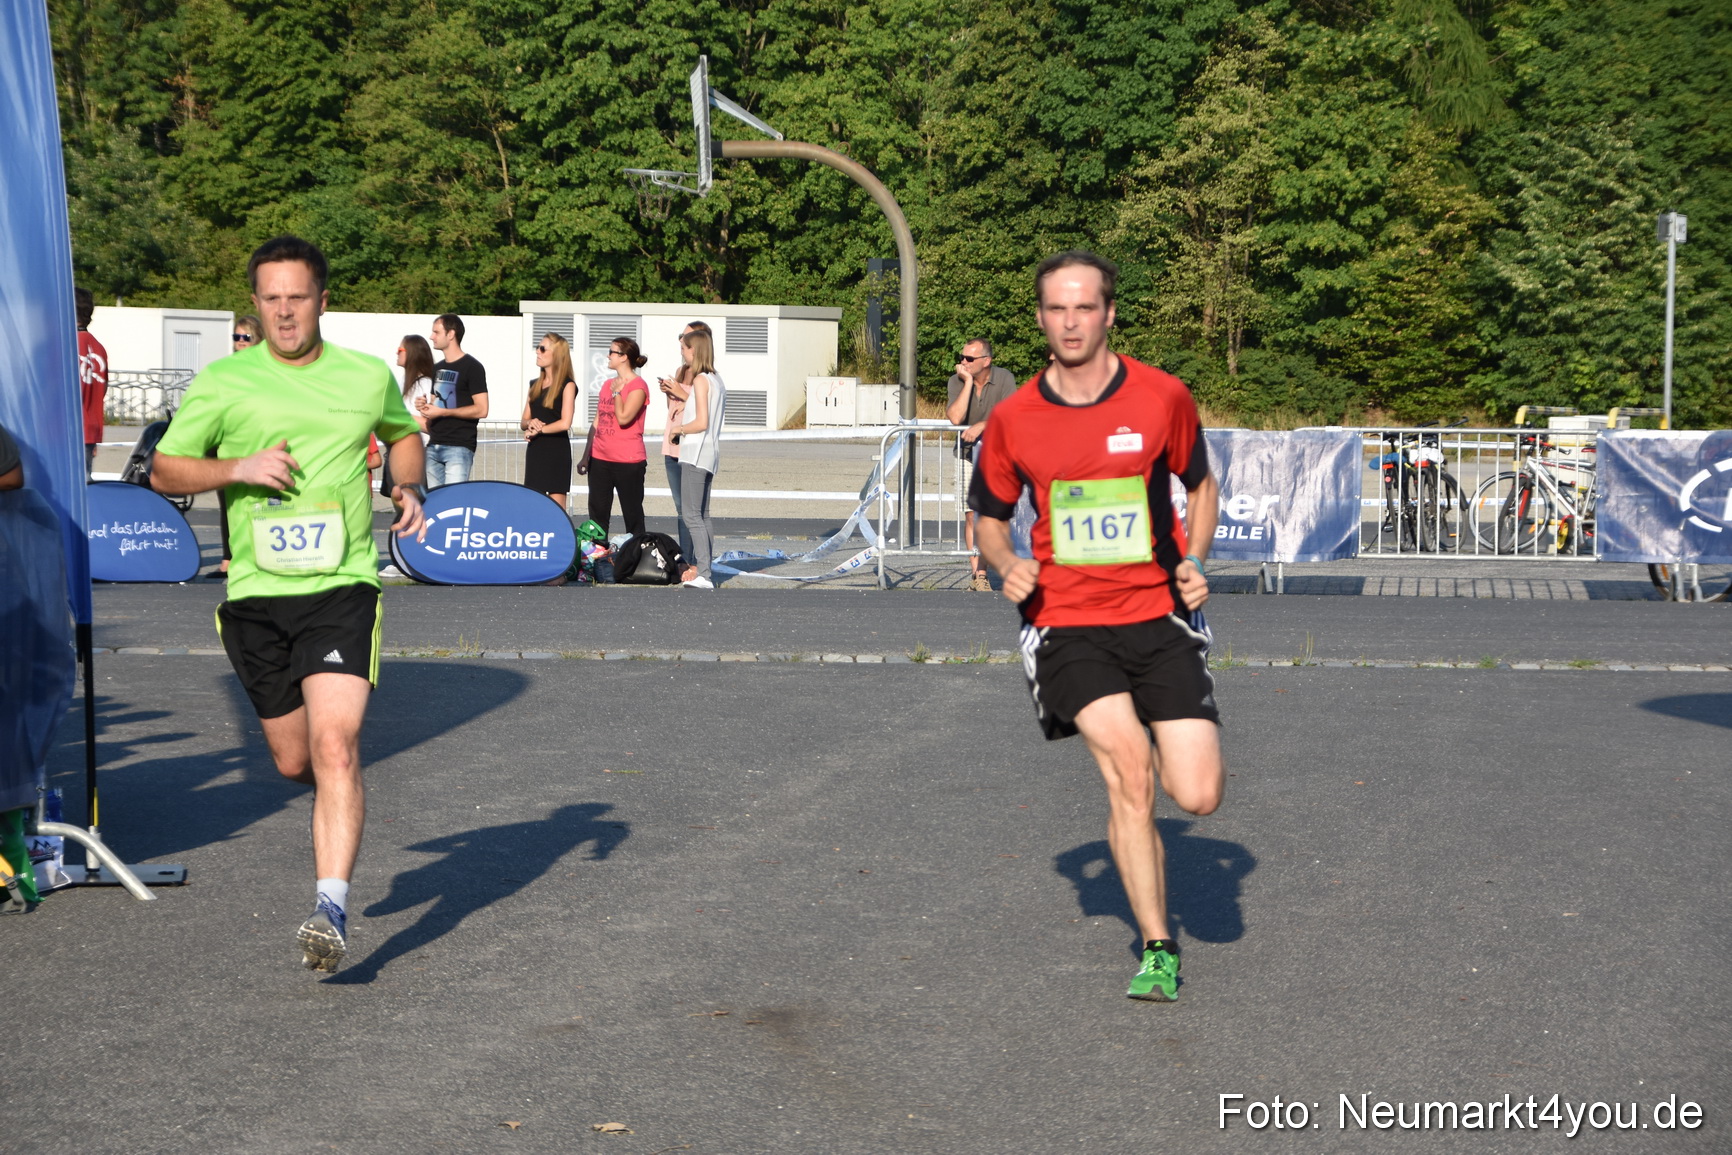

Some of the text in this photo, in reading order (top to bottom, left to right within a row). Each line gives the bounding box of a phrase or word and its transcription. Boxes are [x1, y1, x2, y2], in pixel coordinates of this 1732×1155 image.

[110, 521, 133, 535] das
[269, 522, 326, 552] 337
[1062, 512, 1138, 541] 1167
[118, 538, 179, 557] fährt mit!
[444, 526, 555, 549] Fischer
[456, 550, 548, 561] AUTOMOBILE
